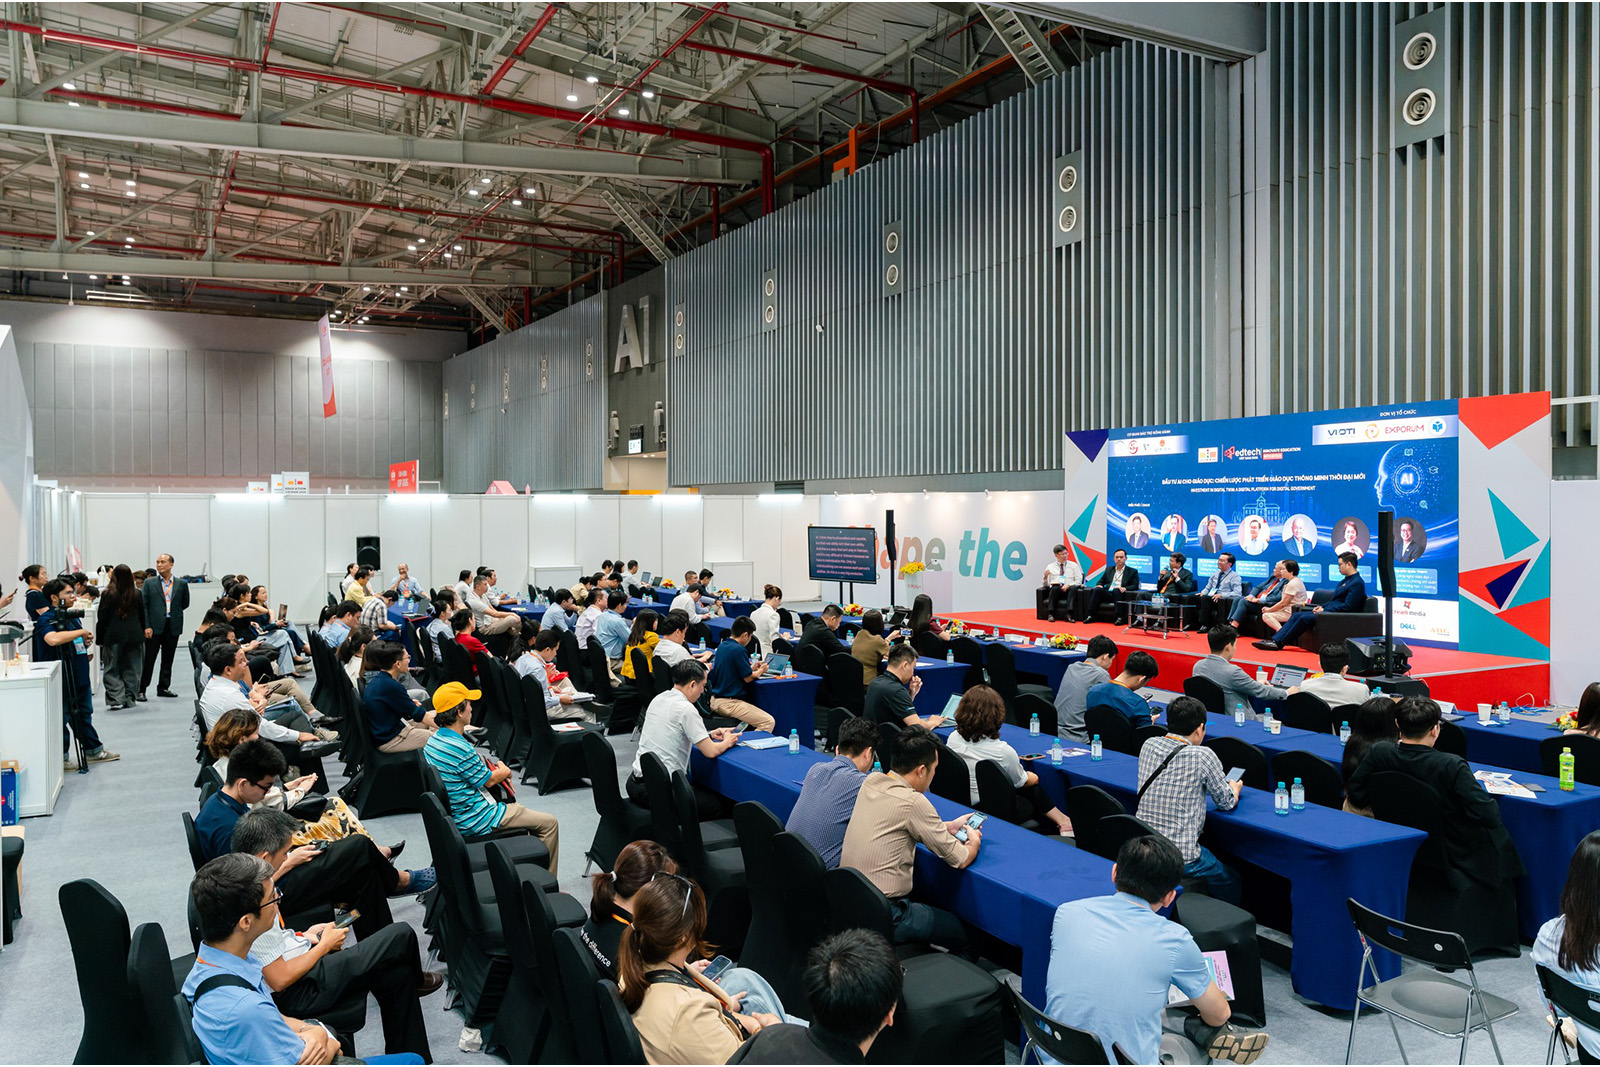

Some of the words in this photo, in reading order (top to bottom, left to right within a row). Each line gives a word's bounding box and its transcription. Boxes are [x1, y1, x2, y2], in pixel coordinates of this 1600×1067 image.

[614, 295, 655, 373] A1
[1384, 424, 1424, 434] EXPORUM
[1235, 448, 1260, 456] edtech
[1400, 472, 1414, 485] AI
[958, 527, 1028, 581] the
[588, 940, 611, 967] difference
